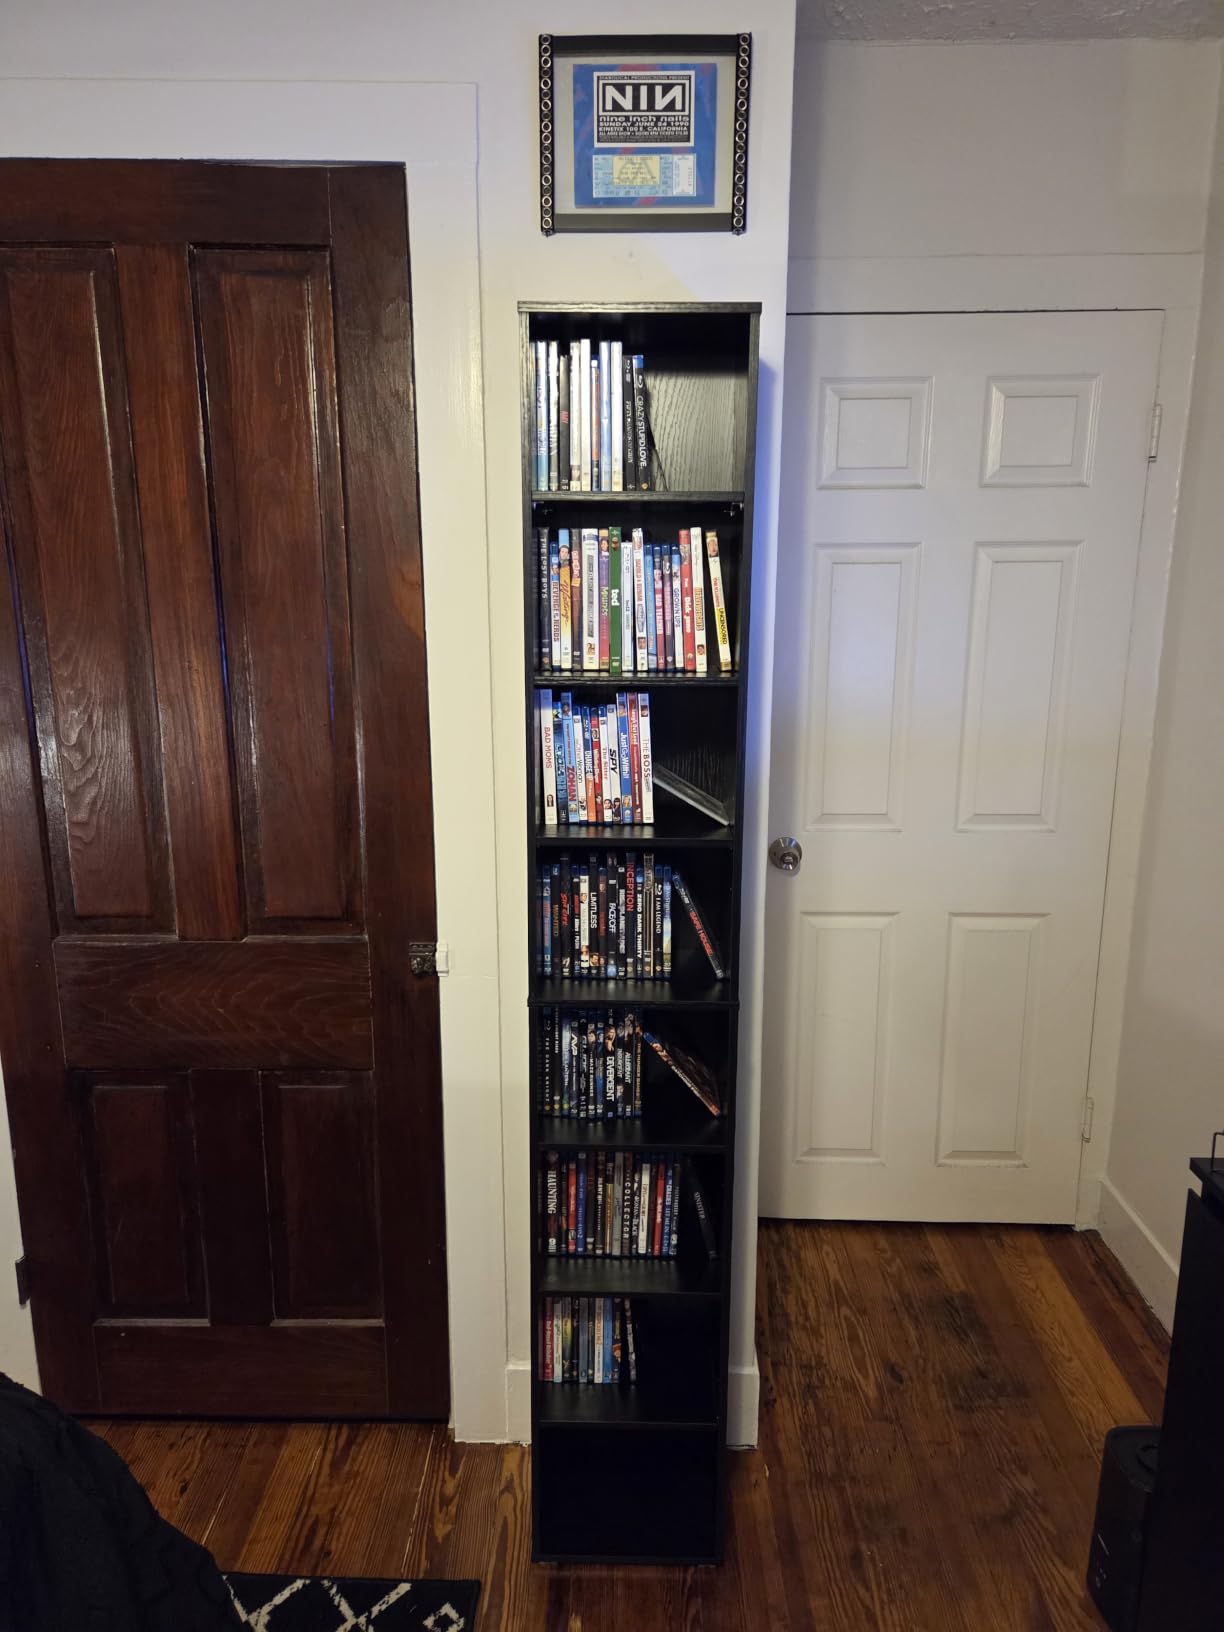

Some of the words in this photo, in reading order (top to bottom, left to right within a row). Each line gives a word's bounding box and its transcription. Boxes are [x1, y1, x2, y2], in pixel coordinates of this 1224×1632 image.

[636, 395, 645, 421] CRAZY
[638, 421, 646, 446] STUPID
[552, 582, 560, 612] REVENGE
[611, 589, 620, 606] ted
[673, 588, 681, 614] GROWN
[718, 608, 728, 645] UNCENSORED
[543, 727, 551, 743] BAD
[619, 733, 628, 748] Just
[642, 739, 650, 753] THE
[545, 745, 553, 768] MOMS
[609, 749, 618, 774] SPY
[643, 754, 651, 778] BOSS
[566, 766, 577, 801] ZOHAN
[576, 759, 584, 784] Woman
[625, 863, 635, 912] INCEPTION
[655, 901, 662, 911] AM
[606, 1056, 615, 1102] DIVERGENT
[547, 1170, 557, 1213] HAUNTING
[623, 1182, 631, 1239] COLLECTOR
[694, 1191, 706, 1219] SINISTER
